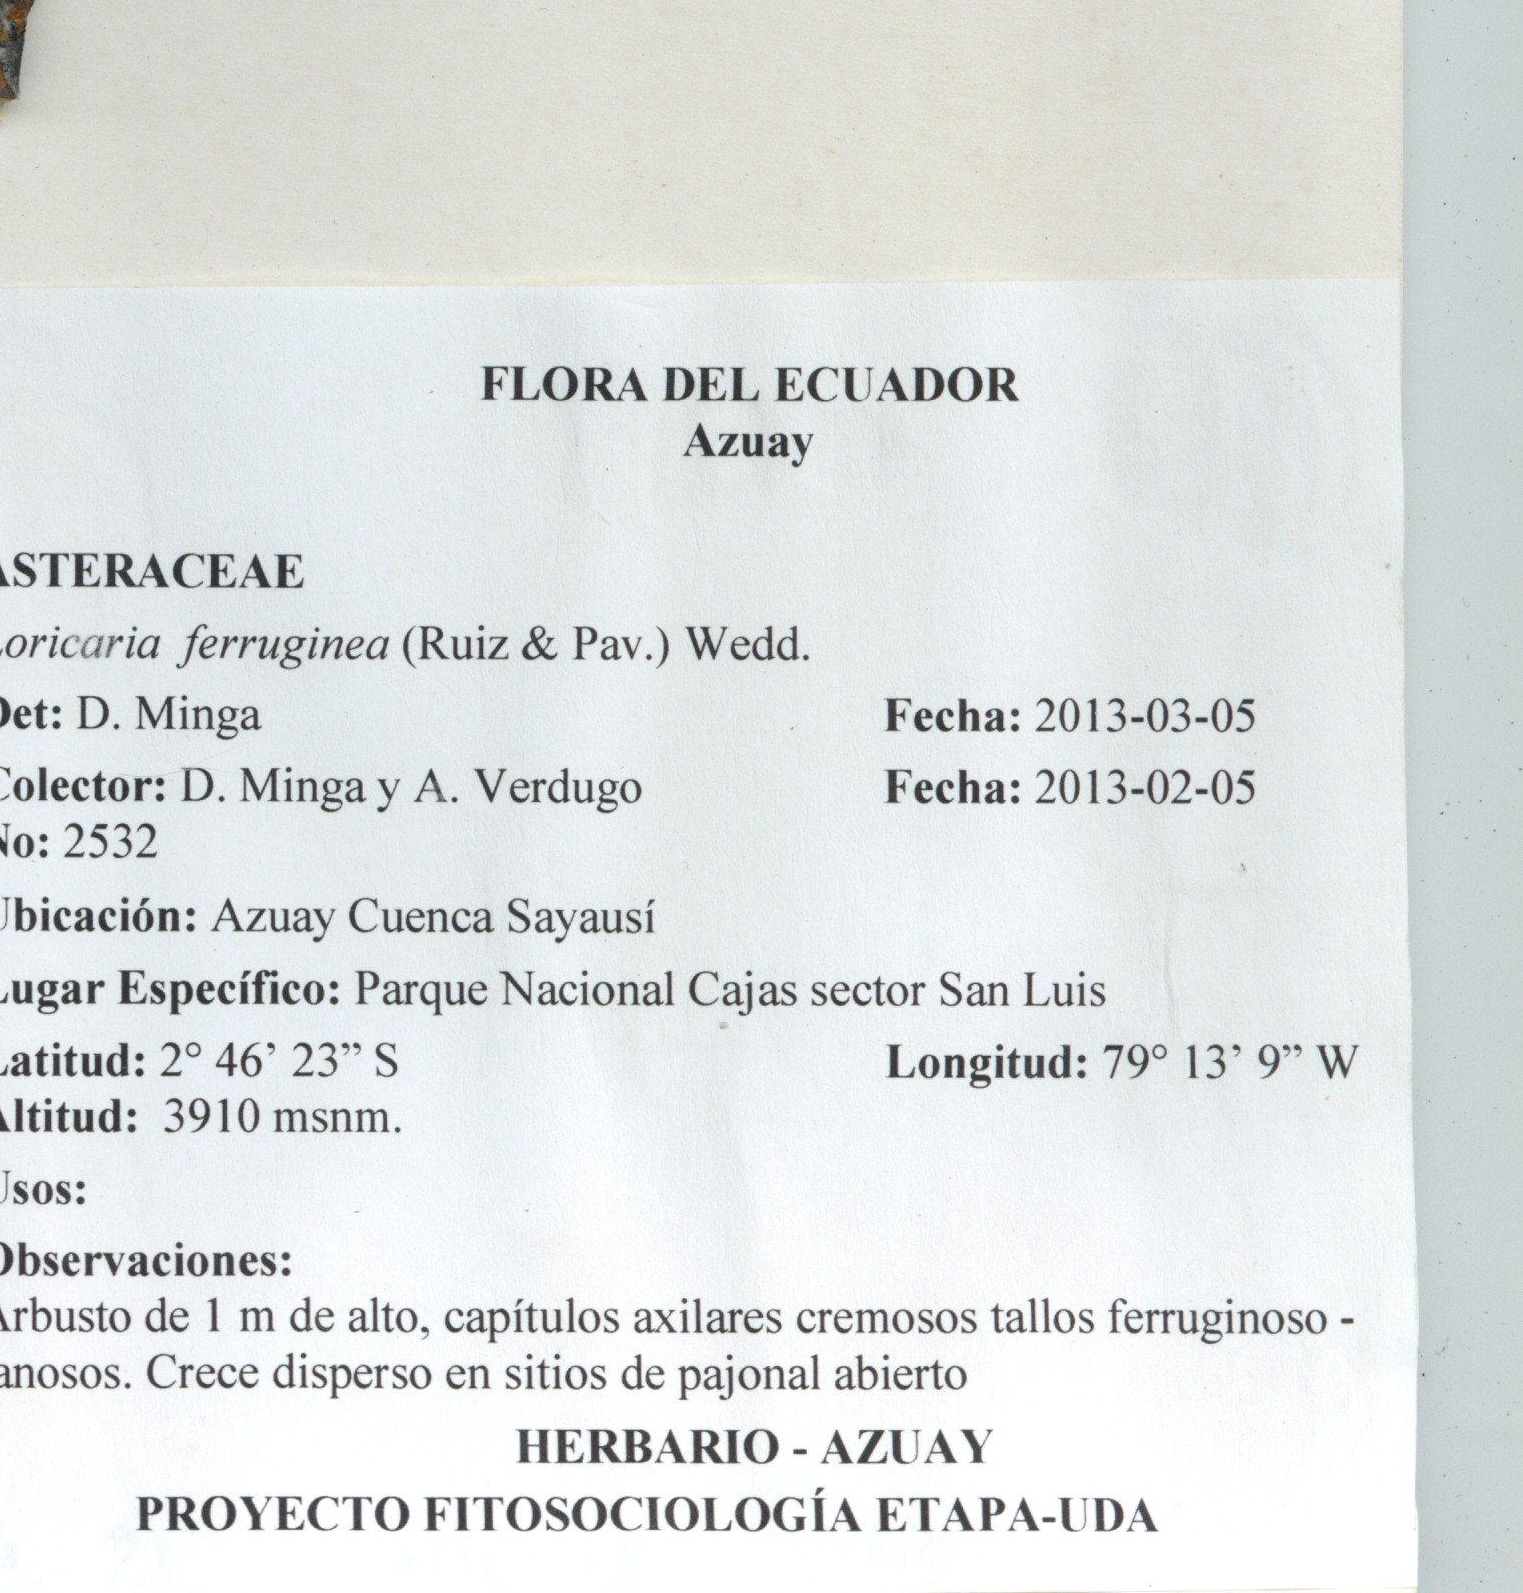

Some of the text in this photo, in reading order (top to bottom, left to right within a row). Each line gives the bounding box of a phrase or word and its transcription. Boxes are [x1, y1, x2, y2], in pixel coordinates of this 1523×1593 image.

[482, 365, 1020, 403] FLORA DEL ECUADOR
[682, 422, 814, 468] Azuay
[175, 623, 390, 670] ferruginea
[402, 624, 509, 668] (Ruiz
[521, 625, 558, 661] &
[574, 626, 670, 668] Pav.)
[685, 625, 810, 661] Wedd.
[77, 695, 120, 730] D.
[135, 694, 262, 741] Minga
[886, 697, 1255, 733] Fecha: 2013-03-05
[181, 767, 225, 803] D.
[240, 766, 367, 813] Minga
[376, 778, 401, 813] y
[414, 768, 458, 803] A.
[474, 767, 642, 814] Verdugo
[886, 768, 1255, 805] Fecha: 2013-02-05
[64, 822, 158, 859] 2532
[211, 897, 336, 943] Azuay
[348, 897, 495, 934] Cuenca
[507, 897, 655, 944] Sayausí
[119, 969, 339, 1015] Específico:
[355, 970, 488, 1016] Parque
[499, 970, 674, 1007] Nacional
[688, 970, 798, 1017] Cajas
[811, 976, 926, 1007] sector
[940, 971, 1009, 1007] San
[1024, 970, 1106, 1007] Luis
[375, 1042, 398, 1078] S
[887, 1043, 1087, 1089] Longitud:
[1316, 1044, 1359, 1079] W
[164, 1097, 260, 1133] 3910
[273, 1108, 401, 1134] msnm.
[145, 1296, 189, 1333] de
[207, 1297, 220, 1332] 1
[240, 1307, 275, 1332] m
[290, 1296, 335, 1333] de
[348, 1297, 430, 1334] alto,
[444, 1297, 620, 1344] capítulos
[634, 1297, 783, 1334] axilares
[796, 1309, 978, 1334] cremosos
[990, 1297, 1095, 1334] tallos
[1108, 1297, 1328, 1345] ferruginoso
[146, 1353, 259, 1389] Crece
[273, 1352, 432, 1399] disperso
[446, 1364, 491, 1390] en
[505, 1353, 607, 1390] sitios
[621, 1353, 665, 1391] de
[678, 1354, 820, 1401] pajonal
[834, 1354, 968, 1391] abierto
[518, 1428, 779, 1465] HERBARIO
[821, 1429, 993, 1465] AZUAY
[137, 1495, 1158, 1532] PROYECTO FITOSOCIOLOGÍA ETAPA-UDA
